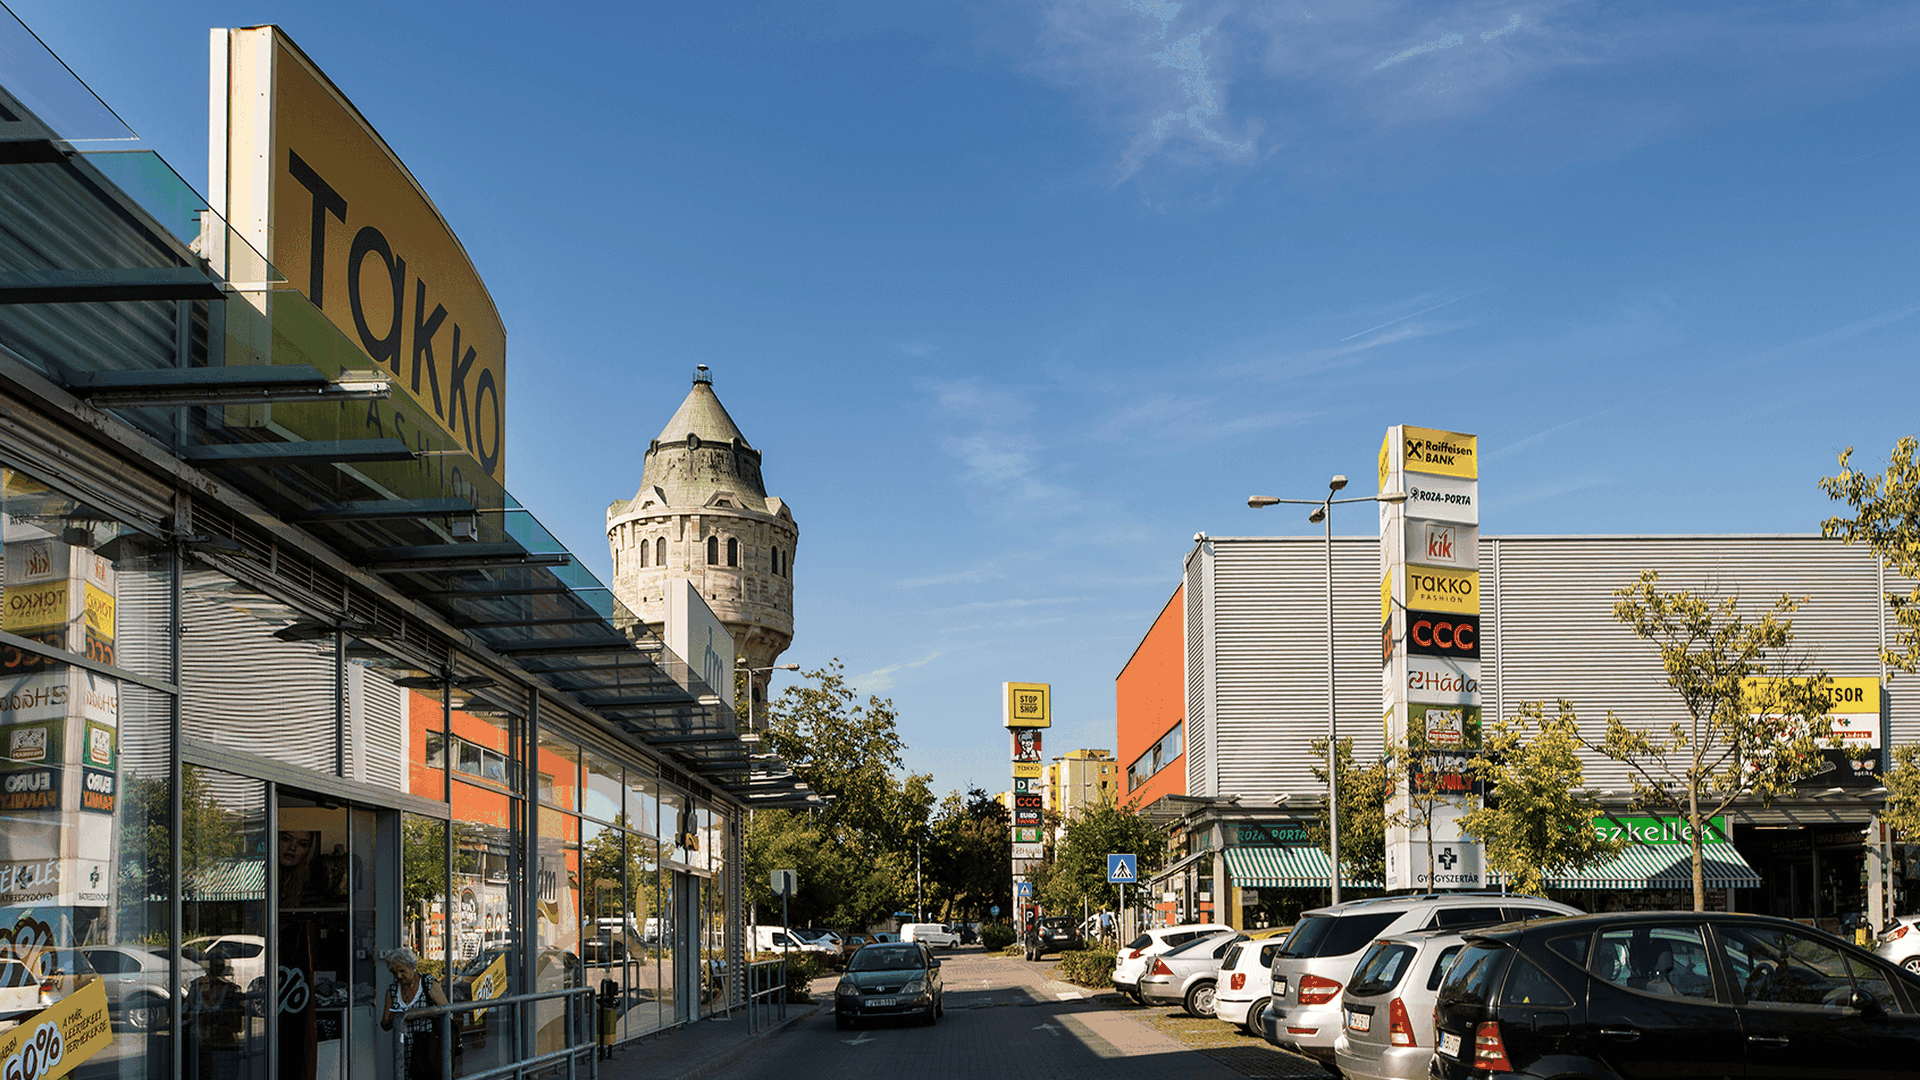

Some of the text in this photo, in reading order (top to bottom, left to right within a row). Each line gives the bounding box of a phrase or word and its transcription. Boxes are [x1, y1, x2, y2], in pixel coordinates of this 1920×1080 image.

[1425, 440, 1472, 456] Raiffeisen
[1425, 453, 1455, 466] BANK
[1421, 594, 1463, 603] FASHION
[1412, 620, 1474, 651] CCC
[1425, 671, 1478, 693] Háda
[1019, 695, 1038, 704] STOP
[1019, 705, 1038, 714] SHOP
[1016, 797, 1041, 808] CCC
[0, 858, 62, 894] ÉKELÉS
[1417, 871, 1479, 884] GYGYSZERTÁR
[1026, 910, 1034, 922] P
